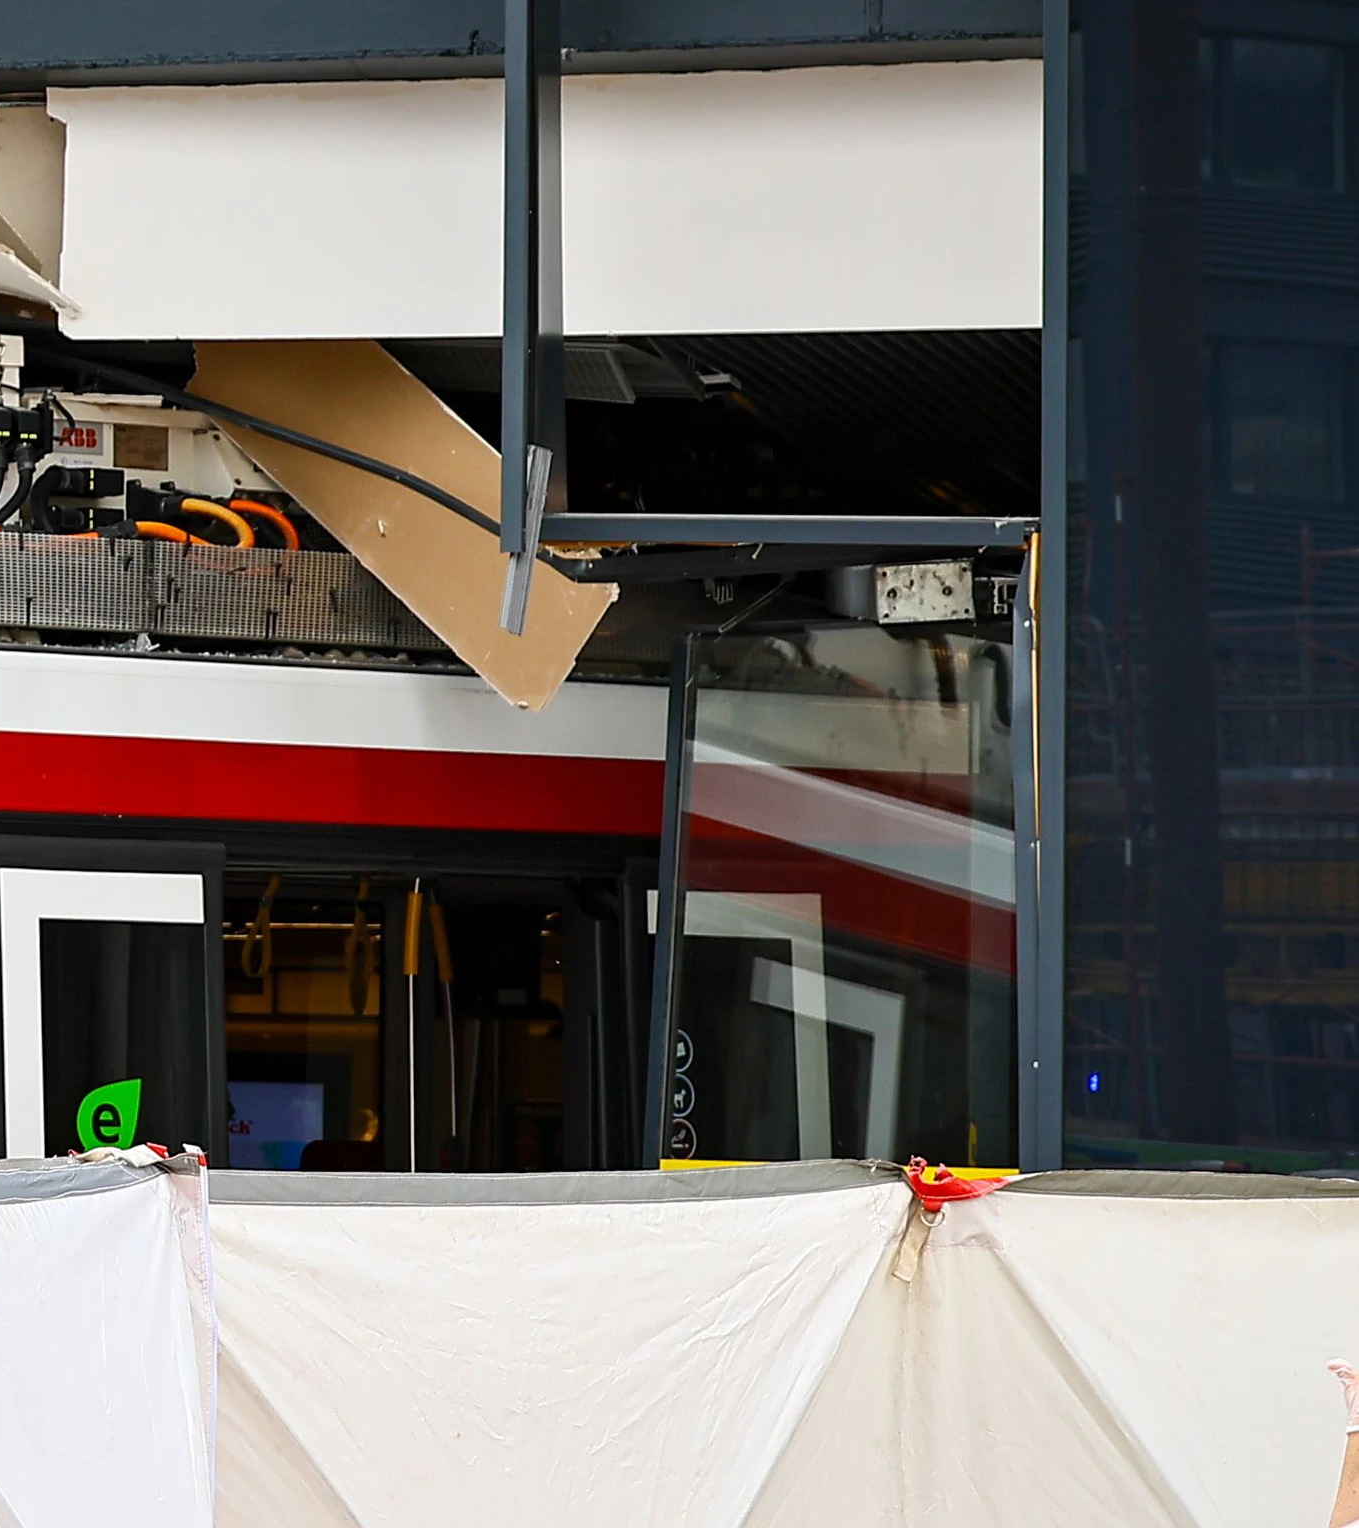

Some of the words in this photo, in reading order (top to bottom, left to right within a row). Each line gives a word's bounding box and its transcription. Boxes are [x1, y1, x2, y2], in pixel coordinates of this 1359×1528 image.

[58, 426, 98, 449] ABB
[91, 1102, 121, 1144] e
[229, 1119, 251, 1135] ch
